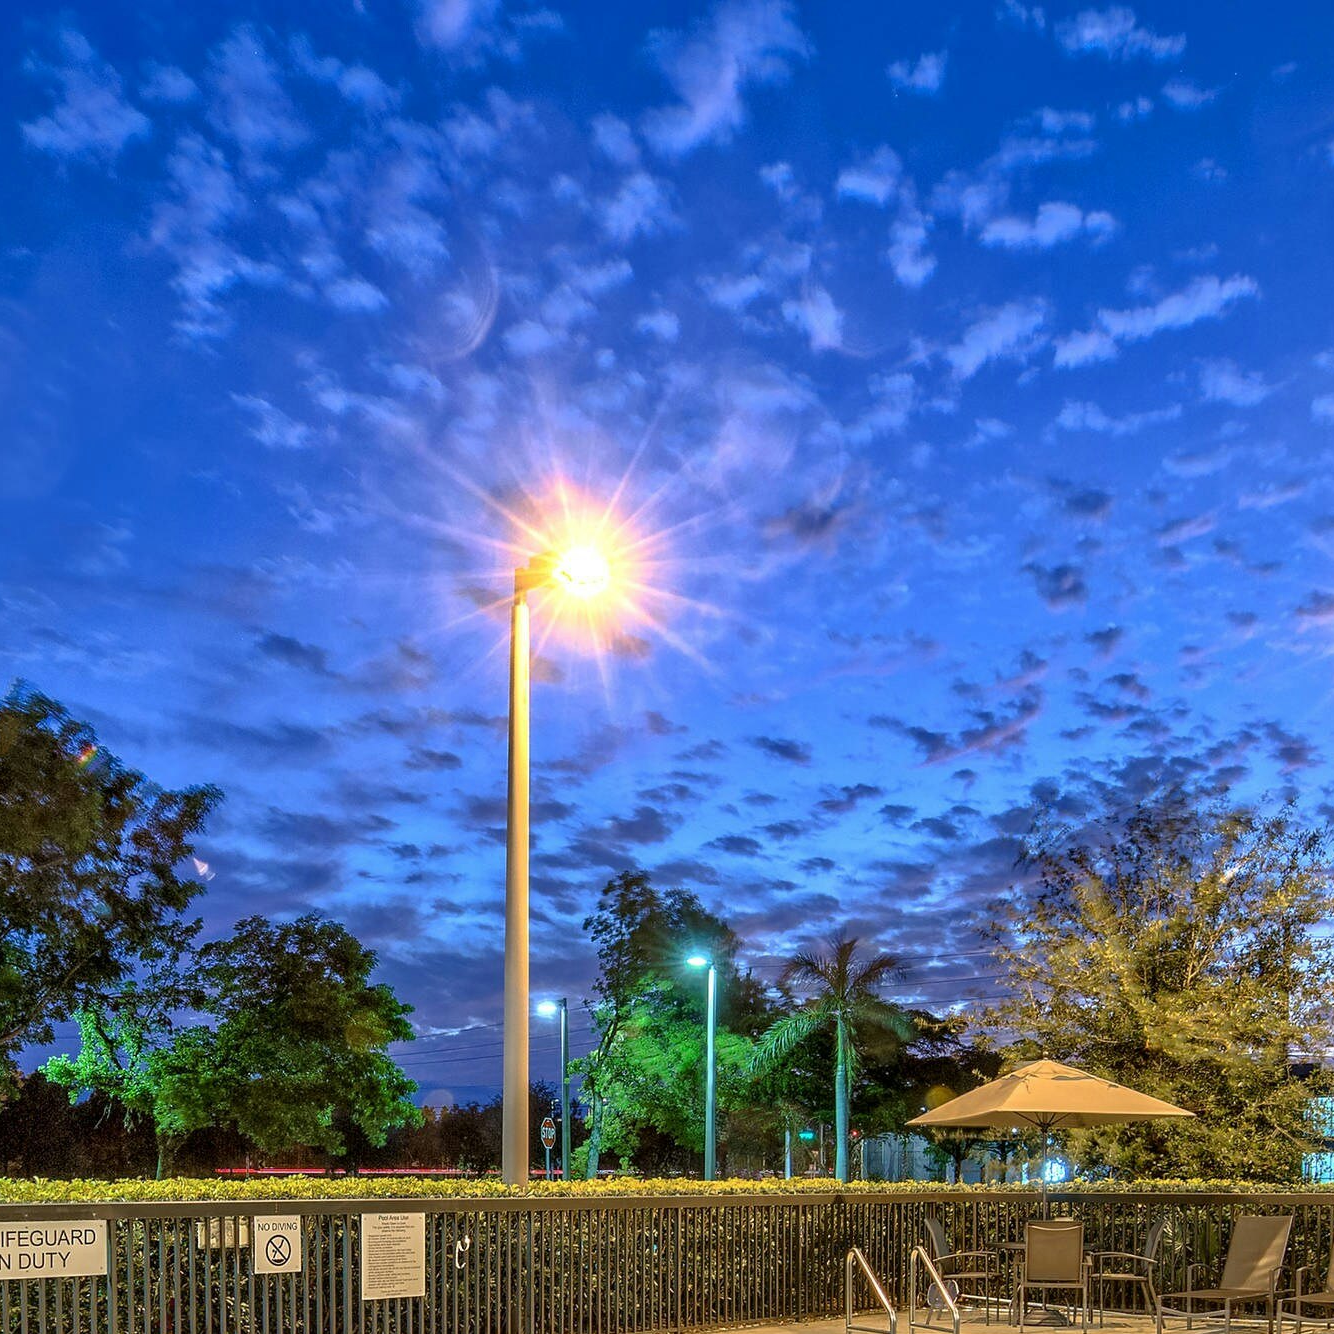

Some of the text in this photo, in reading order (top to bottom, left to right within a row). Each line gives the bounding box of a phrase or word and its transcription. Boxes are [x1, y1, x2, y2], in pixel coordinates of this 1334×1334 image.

[540, 1127, 555, 1139] STOP
[257, 1222, 298, 1231] NO DIVING
[19, 1251, 71, 1270] DUTY
